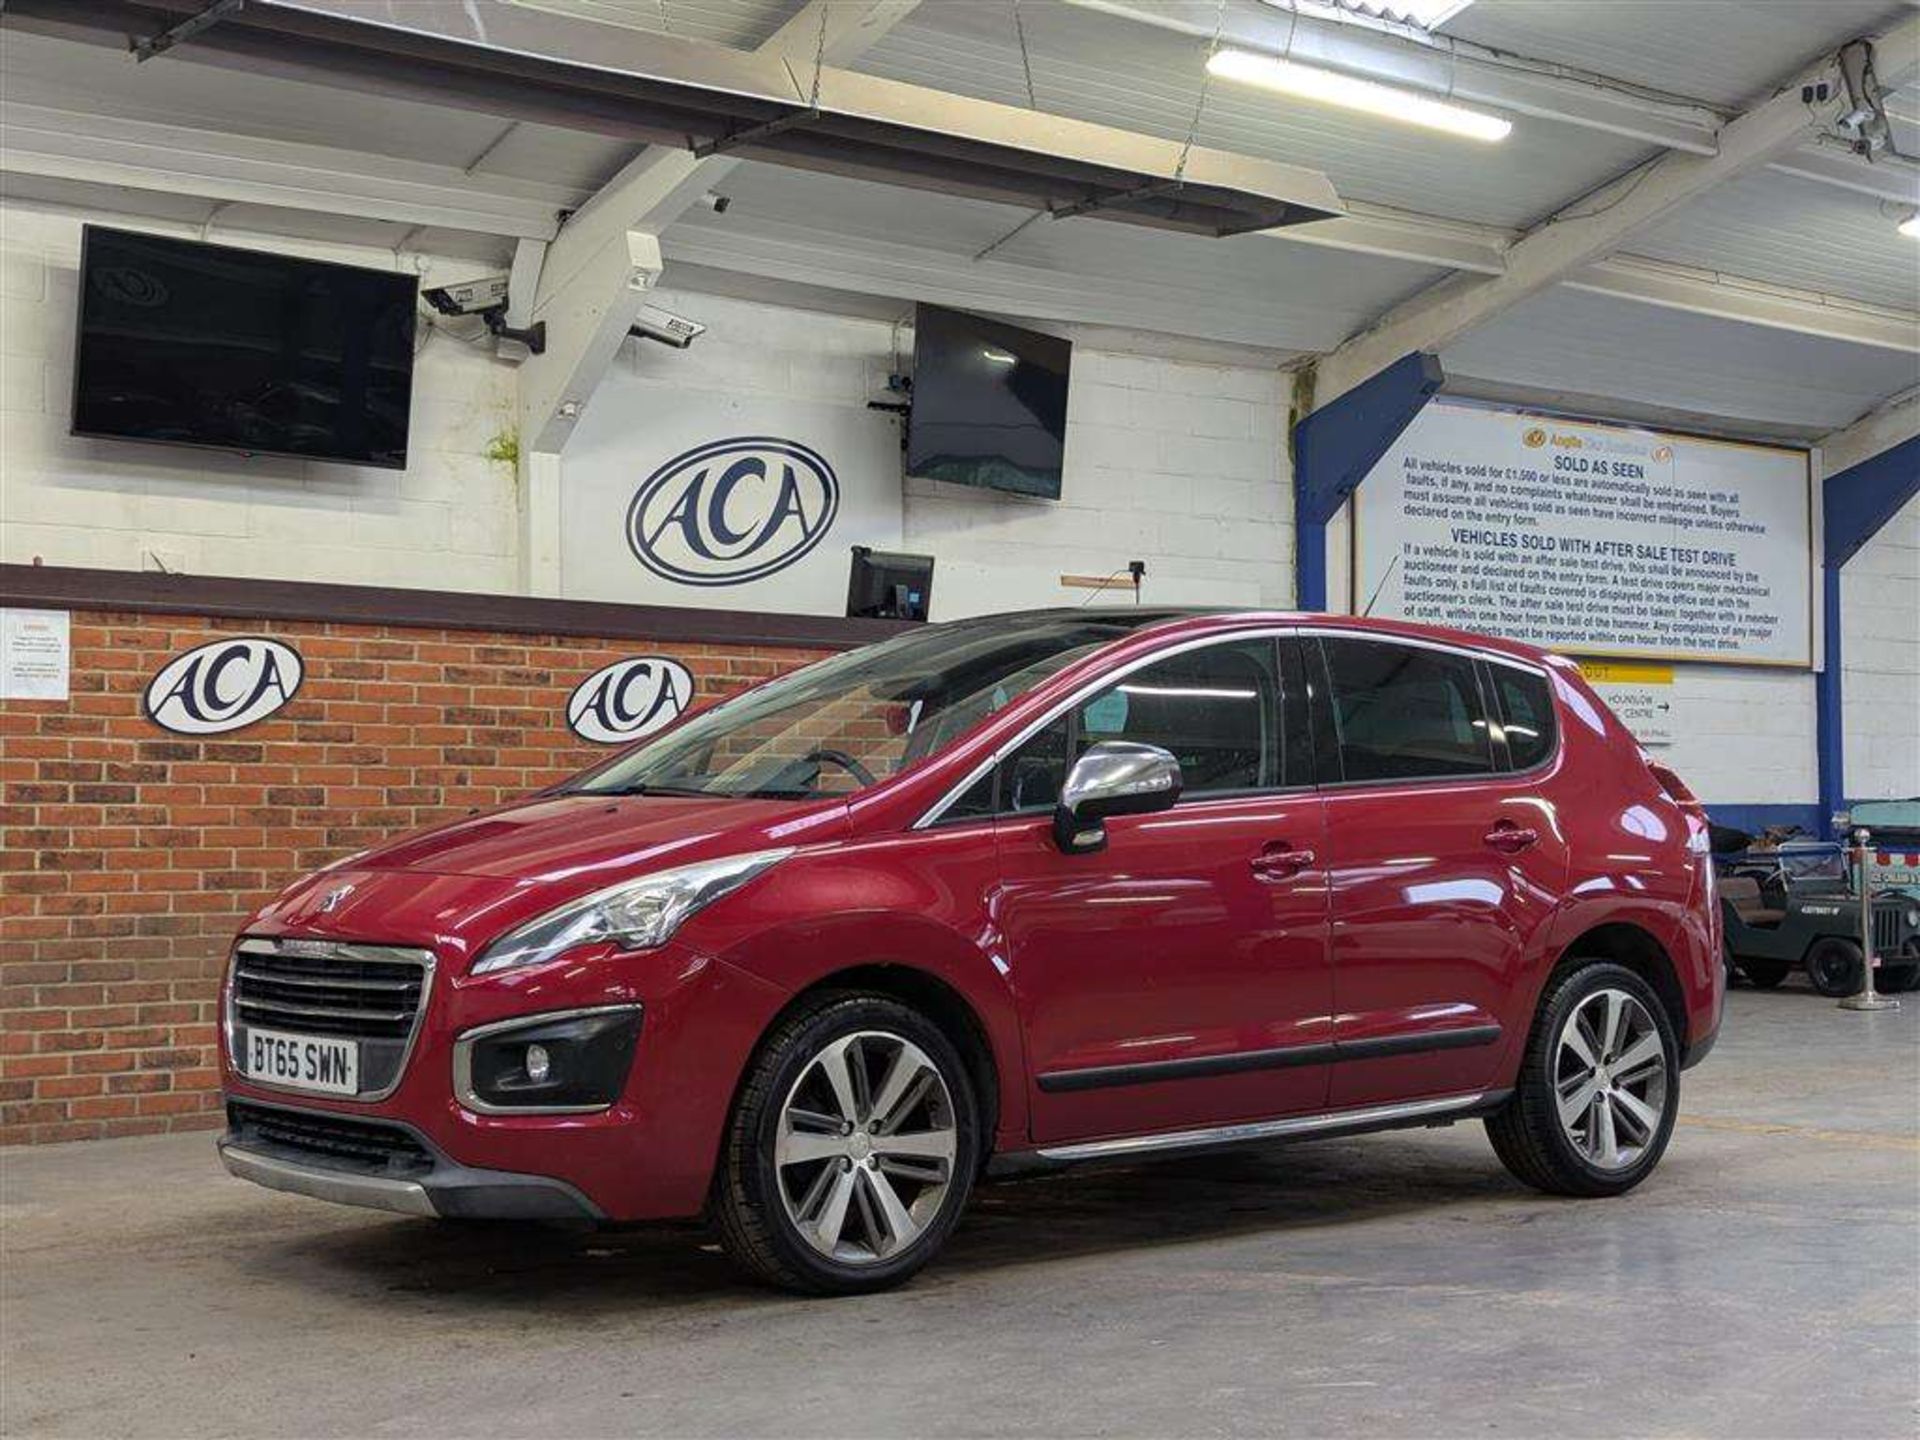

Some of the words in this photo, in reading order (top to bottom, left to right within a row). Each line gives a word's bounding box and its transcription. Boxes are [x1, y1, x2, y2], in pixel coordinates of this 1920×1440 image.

[1404, 456, 1417, 470] All
[1420, 459, 1461, 474] vehicles
[1465, 464, 1486, 477] sold
[1489, 465, 1502, 479] for
[1552, 472, 1570, 485] less
[1573, 477, 1587, 487] are
[1591, 476, 1649, 497] automatically
[1653, 483, 1671, 496] sold
[1687, 488, 1706, 499] seen
[1709, 488, 1726, 501] with
[1729, 490, 1739, 503] all
[1554, 455, 1588, 473] SOLD
[1592, 459, 1607, 475] AS
[1612, 461, 1643, 478] SEEN
[646, 457, 812, 560] ACA
[1404, 489, 1429, 501] must
[1474, 494, 1485, 507] all
[1489, 496, 1528, 511] vehicles
[1532, 500, 1552, 513] sold
[1568, 505, 1590, 516] seen
[1592, 505, 1613, 519] have
[1616, 507, 1656, 523] incorrect
[1659, 511, 1692, 529] mileage
[1695, 515, 1722, 529] unless
[1725, 518, 1765, 533] otherwise
[1404, 504, 1447, 518] declared
[1467, 508, 1482, 521] the
[1485, 510, 1510, 526] entry
[1473, 480, 1492, 492] and
[1510, 484, 1561, 500] complaints
[1565, 488, 1617, 504] whatsoever
[1620, 493, 1640, 507] shall
[1711, 501, 1739, 518] Buyers
[1423, 544, 1458, 558] vehicle
[1473, 548, 1494, 561] sold
[1498, 550, 1518, 563] with
[1535, 552, 1556, 566] after
[1560, 555, 1578, 567] sale
[1581, 555, 1597, 569] test
[1629, 559, 1645, 572] this
[1648, 561, 1669, 574] shall
[1685, 566, 1730, 579] announced
[1745, 568, 1758, 581] the
[1450, 528, 1517, 548] VEHICLES
[1521, 534, 1555, 551] SOLD
[1559, 537, 1590, 554] WITH
[1594, 540, 1633, 558] AFTER
[1636, 544, 1667, 561] SALE
[1670, 547, 1699, 564] TEST
[1702, 550, 1736, 567] DRIVE
[1404, 559, 1457, 573] auctioneer
[1460, 563, 1479, 575] and
[1482, 563, 1524, 578] declared
[1542, 568, 1556, 581] the
[1559, 570, 1583, 586] entry
[1621, 574, 1637, 587] test
[1640, 575, 1662, 589] drive
[1665, 580, 1694, 591] covers
[1697, 582, 1721, 596] major
[1723, 582, 1770, 597] mechanical
[1404, 573, 1432, 587] faults
[1471, 578, 1486, 591] full
[1489, 579, 1504, 592] list
[1520, 581, 1546, 595] faults
[1548, 585, 1586, 597] covered
[1599, 586, 1642, 604] displayed
[1656, 590, 1669, 602] the
[1672, 591, 1696, 604] office
[1699, 593, 1714, 605] and
[1717, 594, 1734, 607] with
[1737, 595, 1749, 607] the
[1446, 607, 1475, 620] within
[1479, 611, 1497, 621] one
[1500, 609, 1522, 622] hour
[1525, 611, 1547, 624] from
[1549, 612, 1564, 625] the
[1567, 613, 1581, 626] fall
[1595, 614, 1610, 627] the
[1653, 618, 1668, 634] Any
[1672, 620, 1719, 635] complaints
[1732, 625, 1746, 638] any
[1749, 626, 1772, 639] major
[1500, 595, 1516, 608] The
[1520, 597, 1541, 610] after
[1544, 598, 1563, 611] sale
[1566, 599, 1583, 612] test
[1586, 600, 1608, 614] drive
[1611, 603, 1634, 615] must
[1680, 606, 1715, 622] together
[1718, 608, 1735, 621] with
[1745, 611, 1777, 624] member
[1504, 625, 1529, 637] must
[1546, 628, 1586, 642] reported
[1588, 629, 1615, 642] within
[1618, 633, 1634, 643] one
[1636, 631, 1657, 644] hour
[1660, 633, 1681, 646] from
[1683, 634, 1696, 647] the
[1698, 635, 1715, 648] test
[152, 644, 288, 723] ACA
[570, 663, 681, 733] ACA
[254, 1034, 299, 1079] BT65
[304, 1043, 347, 1086] SWN
